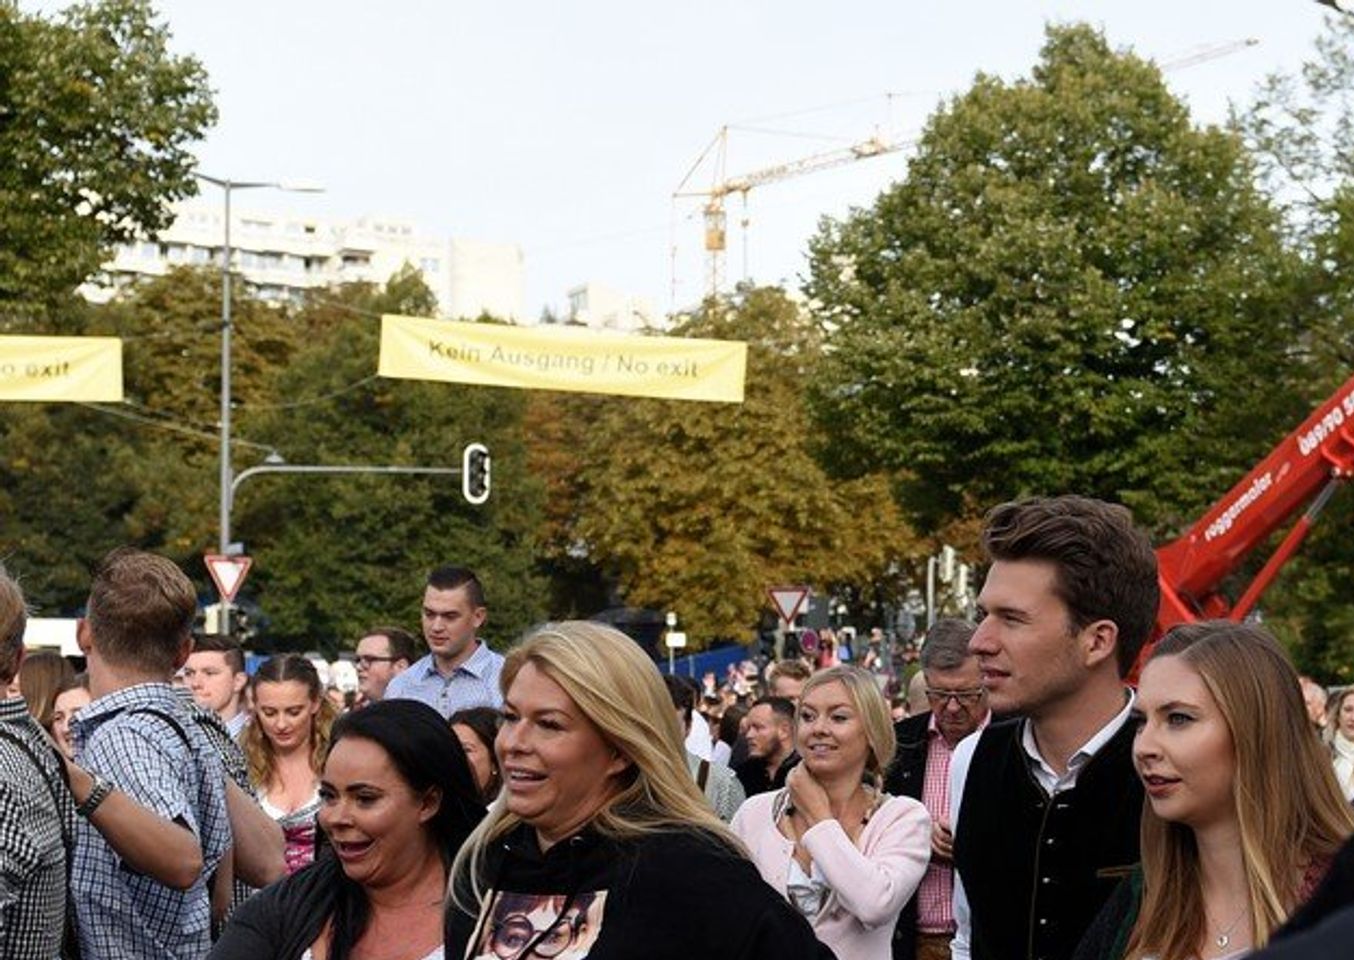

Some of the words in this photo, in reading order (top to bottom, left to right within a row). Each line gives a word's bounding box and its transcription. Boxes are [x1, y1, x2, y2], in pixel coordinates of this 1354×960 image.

[25, 361, 69, 378] exit
[428, 338, 480, 362] Kein
[489, 346, 594, 376] Ausgang
[617, 355, 649, 375] No
[657, 359, 698, 378] exit
